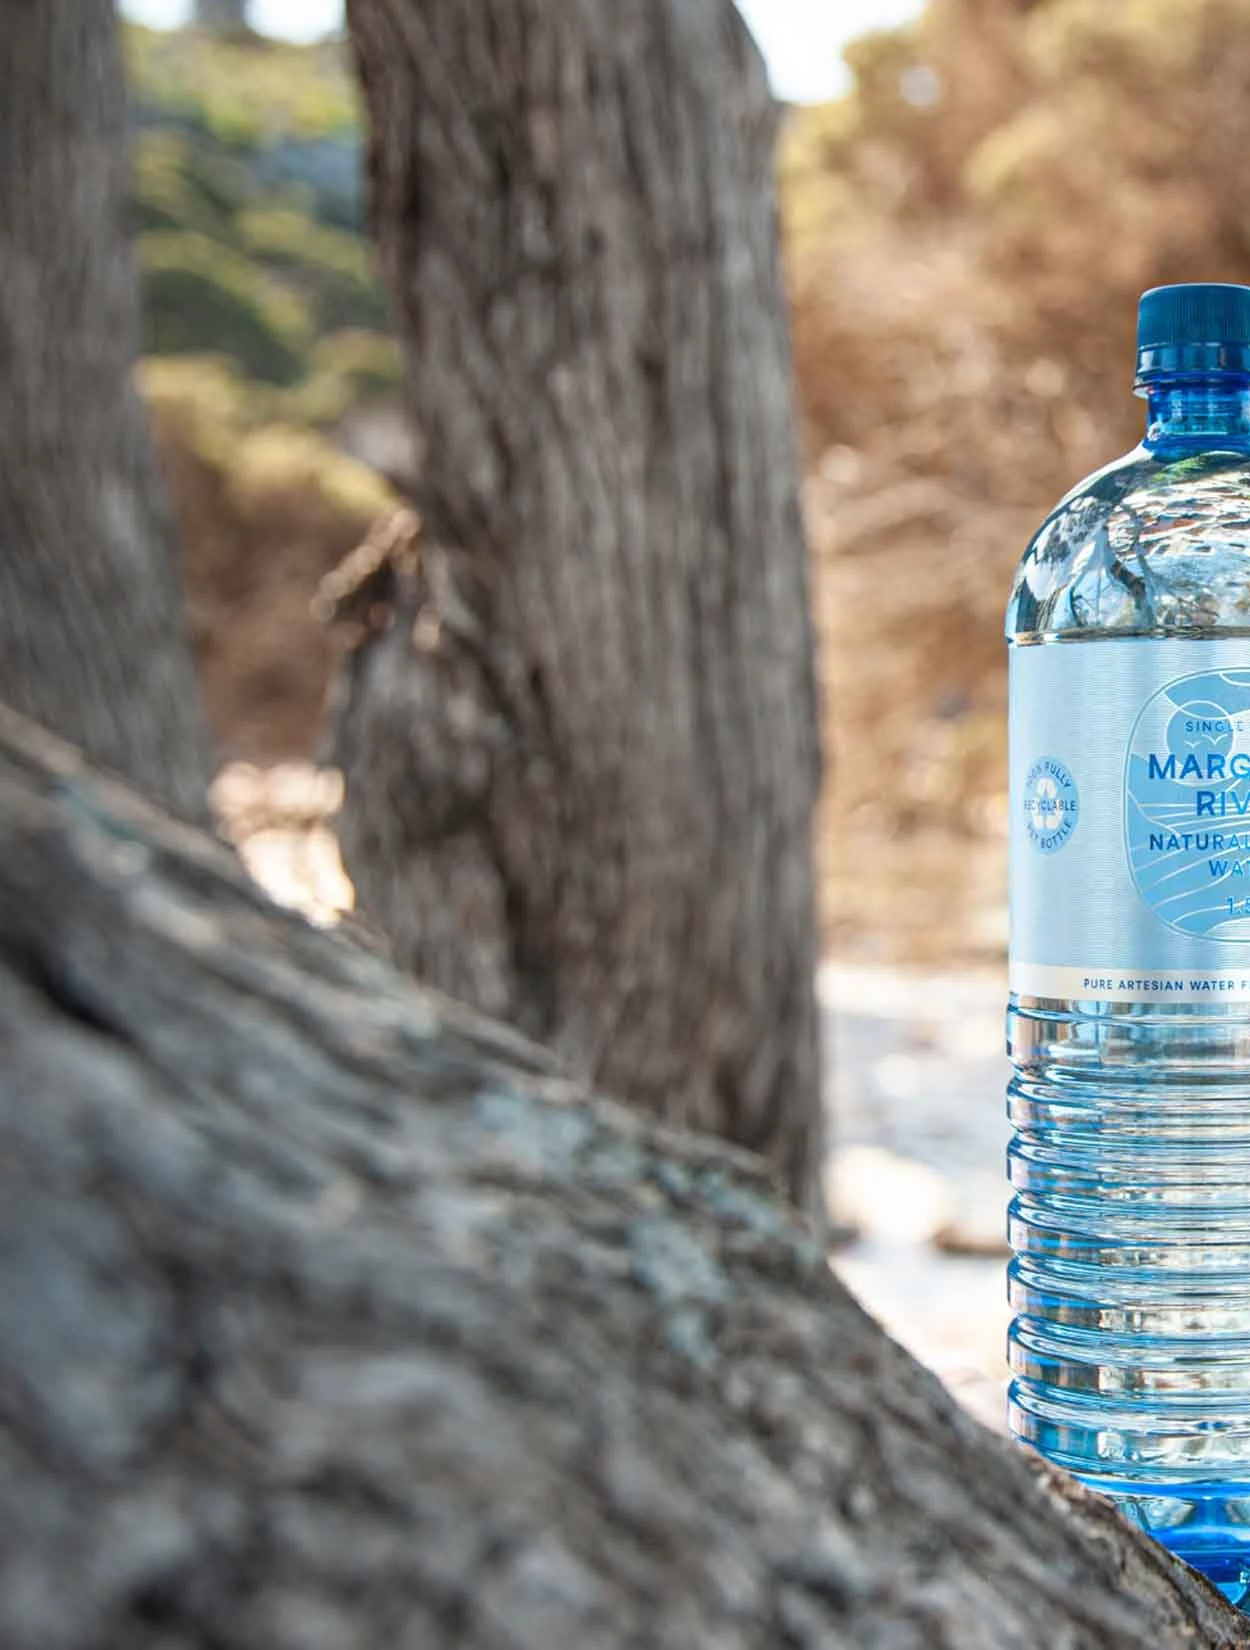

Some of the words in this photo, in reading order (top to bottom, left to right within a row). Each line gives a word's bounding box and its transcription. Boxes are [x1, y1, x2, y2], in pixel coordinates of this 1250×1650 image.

[1185, 721, 1244, 732] SINGLE
[1045, 761, 1071, 788] FULLY
[1084, 978, 1112, 990] PURE
[1118, 980, 1183, 991] ARTESIAN
[1190, 980, 1235, 991] WATER
